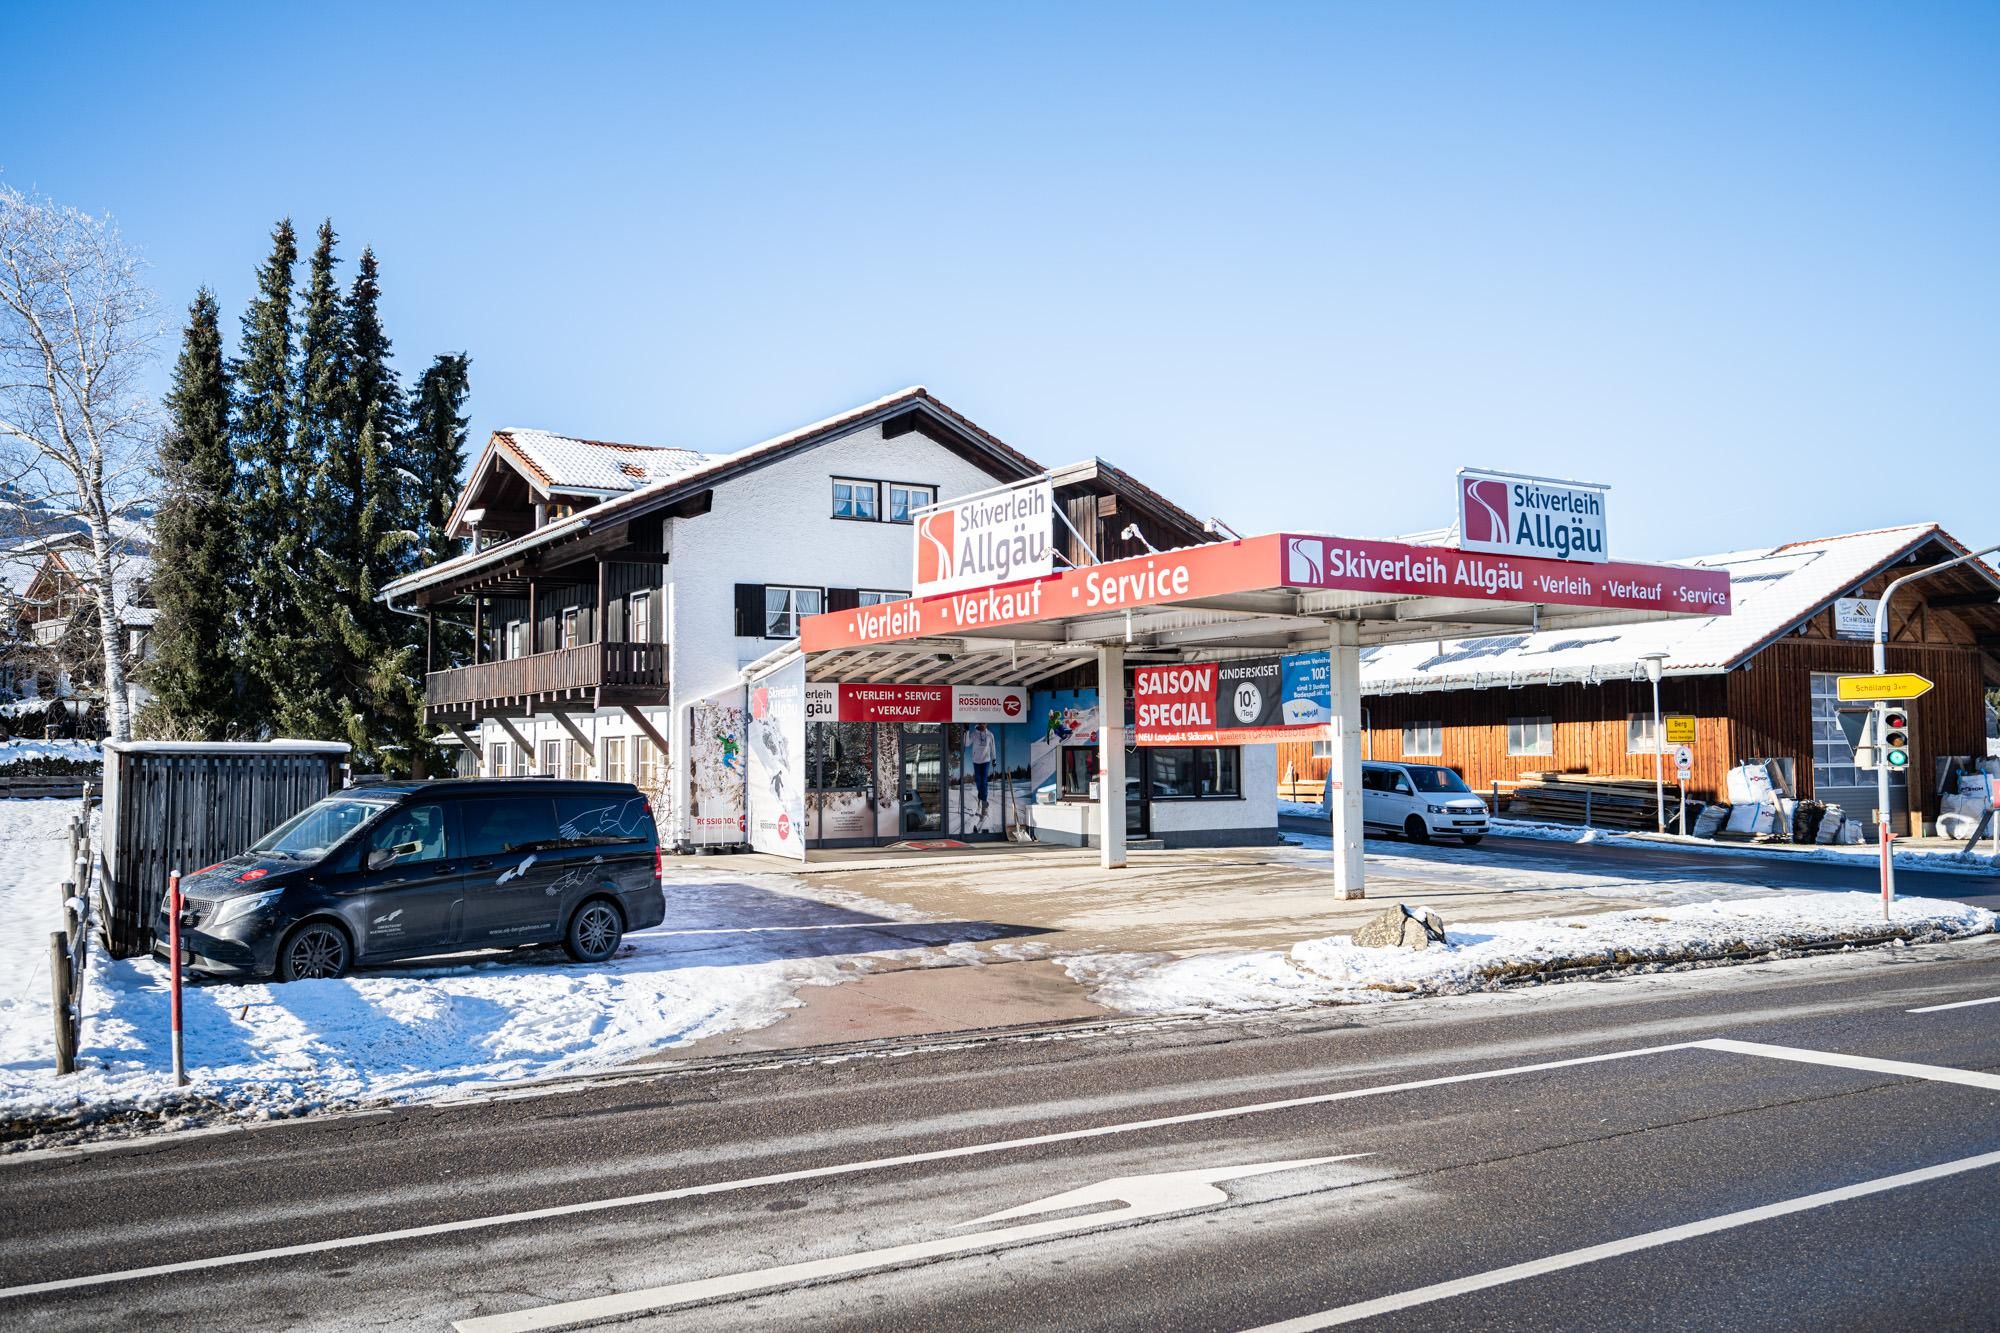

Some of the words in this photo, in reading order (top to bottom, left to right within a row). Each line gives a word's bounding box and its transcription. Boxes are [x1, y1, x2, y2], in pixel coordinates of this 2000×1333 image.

[960, 487, 1045, 532] Skiverleih
[1514, 484, 1600, 516] Skiverleih
[1516, 511, 1602, 559] Allgäu
[959, 523, 1046, 580] Allgäu
[1330, 548, 1448, 583] Skiverleih
[1454, 559, 1524, 595] Allgäu
[1540, 575, 1592, 596] Verleih
[1608, 580, 1662, 601] Verkauf
[1680, 586, 1726, 605] Service
[857, 602, 921, 641] Verleih
[953, 579, 1042, 626] Verkauf
[1086, 560, 1190, 607] Service
[1842, 616, 1876, 625] SCHMIDBAU
[1138, 668, 1211, 696] SAISON
[1218, 664, 1279, 680] KINDERSKISET
[856, 690, 895, 700] VERLEIH
[904, 691, 941, 701] SERVICE
[959, 697, 1002, 706] ROSSIGNOL
[877, 705, 921, 716] VERKAUF
[1138, 702, 1212, 727] SPECIAL
[1138, 733, 1153, 742] NEU
